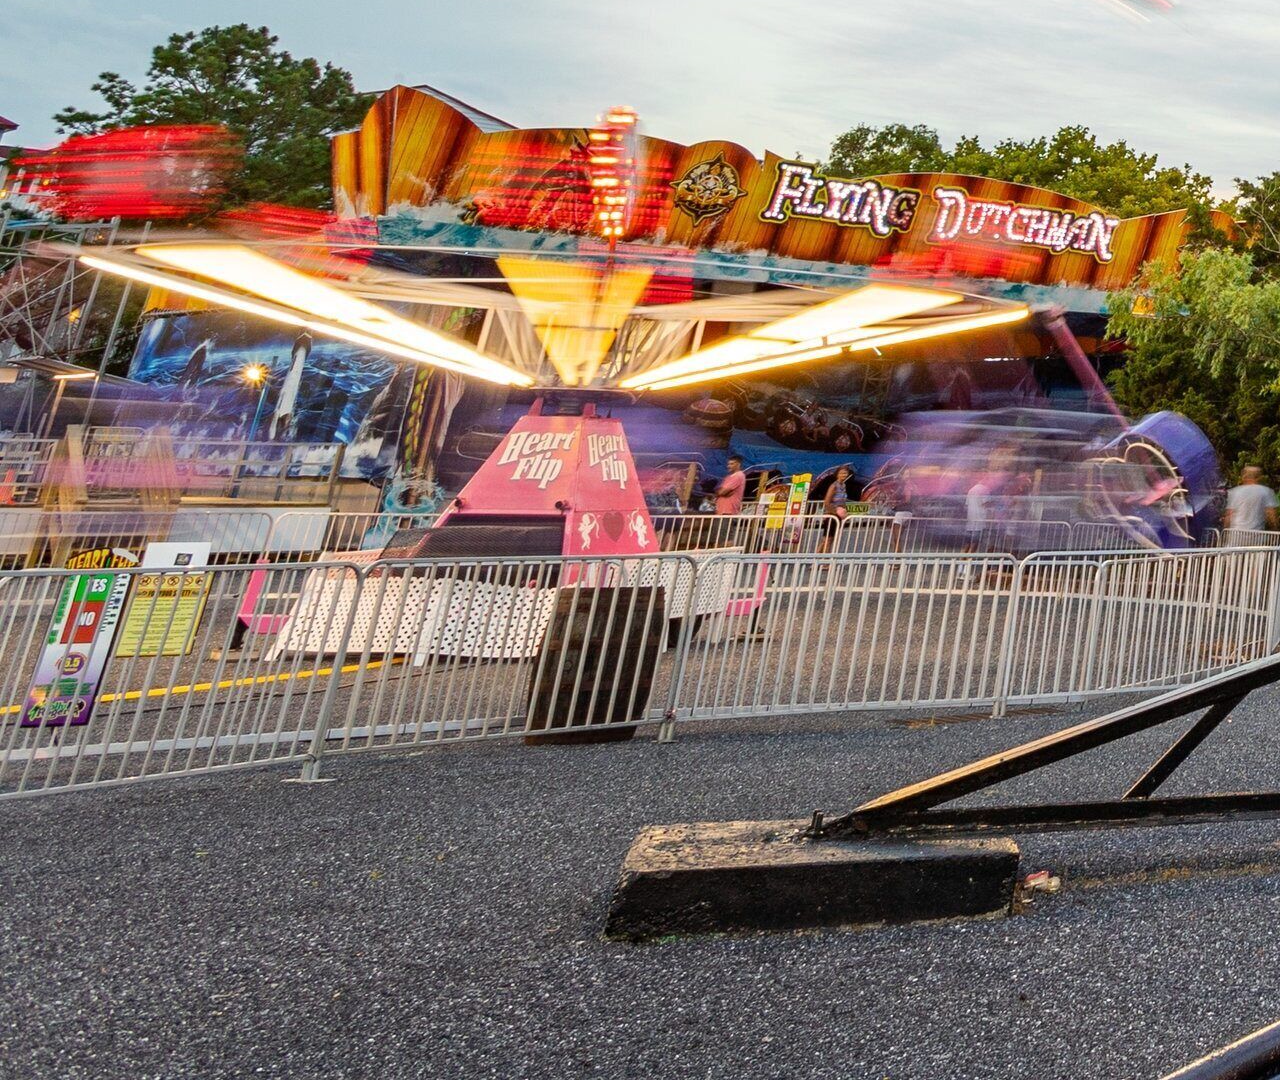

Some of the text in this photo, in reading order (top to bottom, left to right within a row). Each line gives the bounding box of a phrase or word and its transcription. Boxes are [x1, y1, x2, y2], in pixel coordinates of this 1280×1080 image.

[762, 162, 1118, 261] FLYING DUTCHMAN
[497, 430, 576, 465] Heart
[587, 433, 626, 466] Heart
[510, 451, 563, 489] Flip
[601, 453, 628, 489] Flip
[67, 548, 110, 569] HEART
[87, 578, 108, 592] ES
[79, 611, 96, 626] NO
